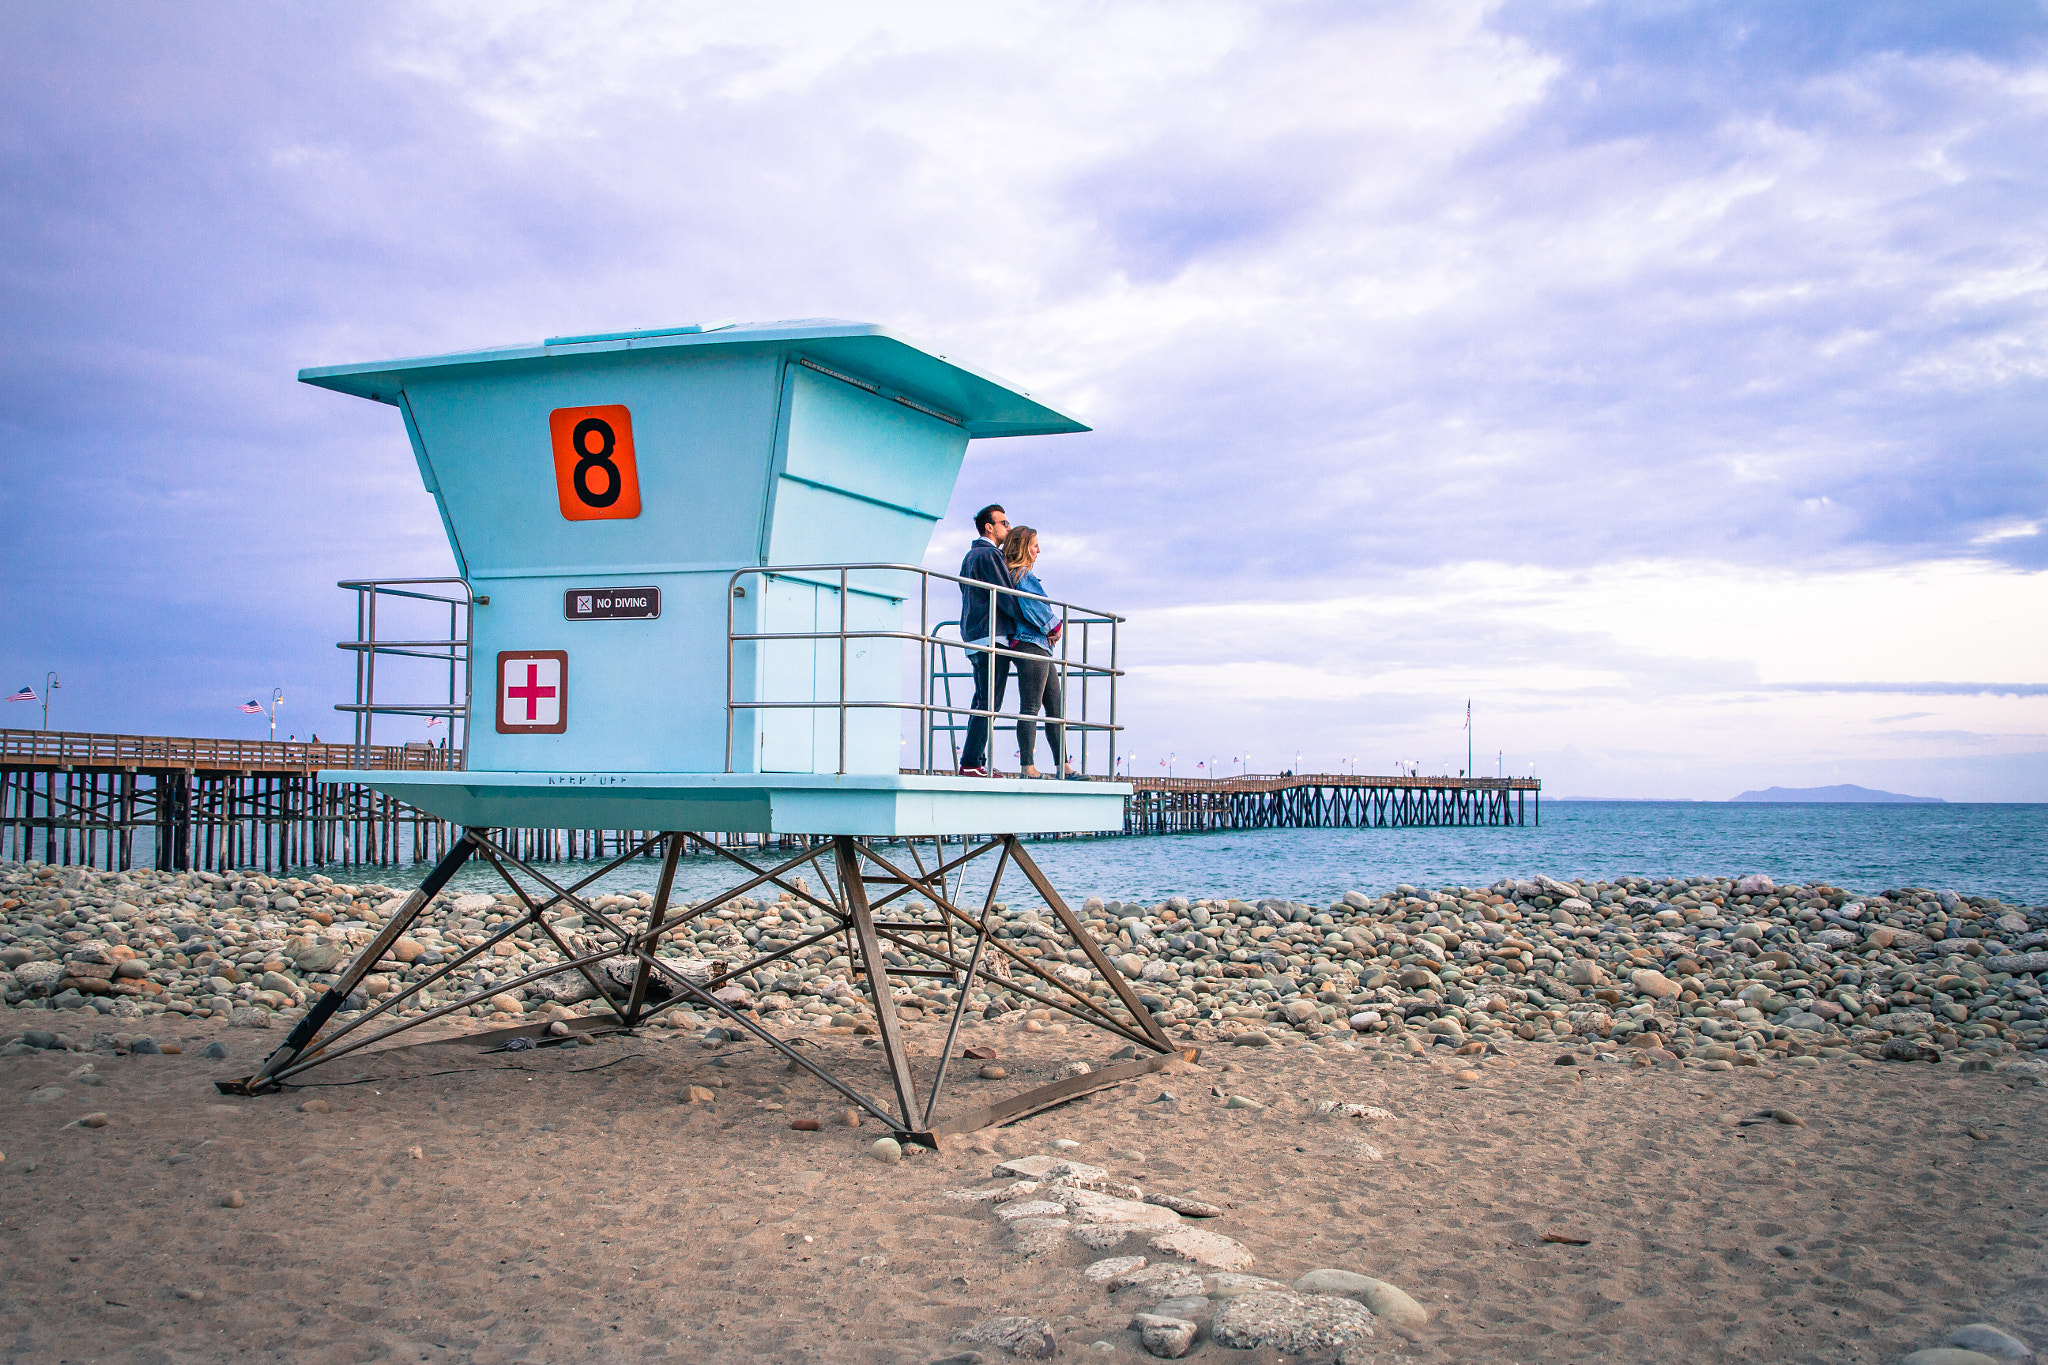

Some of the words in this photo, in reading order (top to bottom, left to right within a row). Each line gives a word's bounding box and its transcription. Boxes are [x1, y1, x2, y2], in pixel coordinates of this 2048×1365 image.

[572, 418, 622, 508] 8
[596, 598, 612, 609] NO
[614, 597, 647, 608] DIVING
